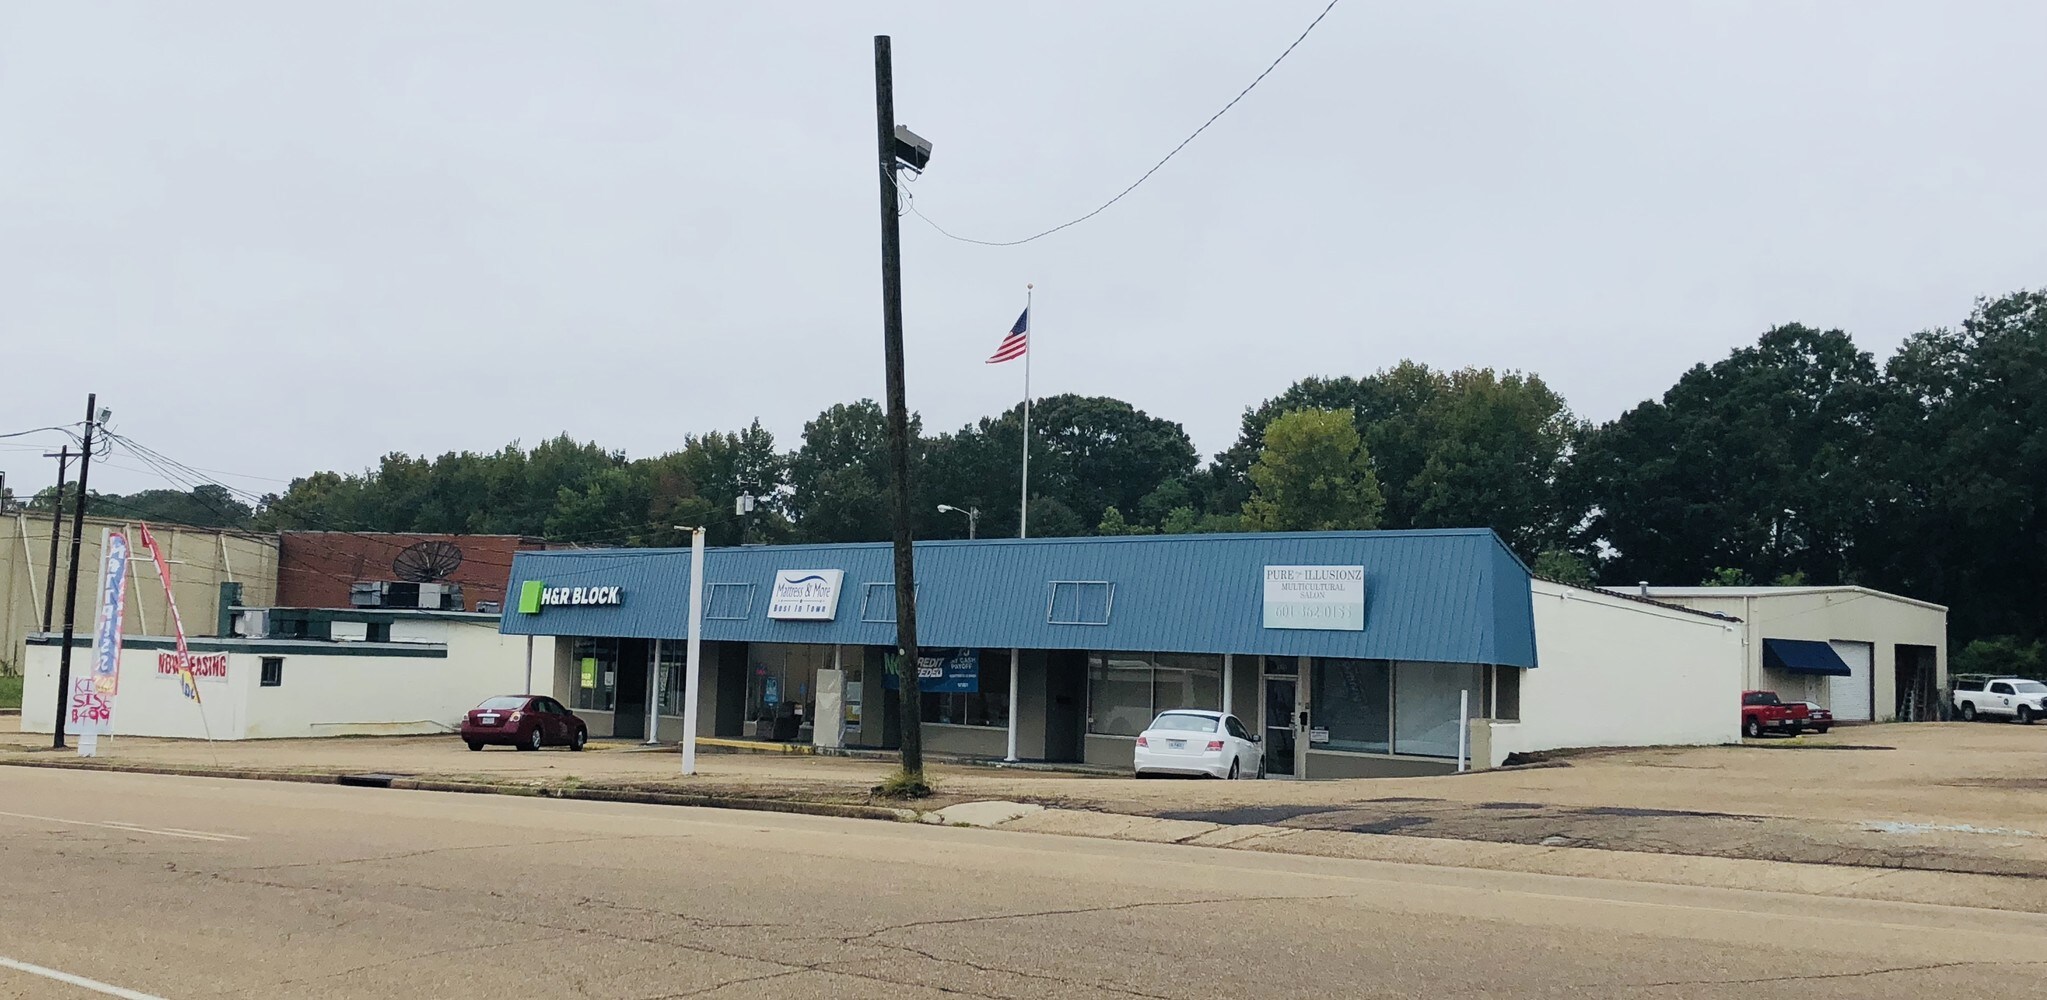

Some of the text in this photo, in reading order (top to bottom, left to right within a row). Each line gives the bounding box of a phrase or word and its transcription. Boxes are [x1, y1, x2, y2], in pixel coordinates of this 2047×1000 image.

[1267, 570, 1362, 581] PURE ILLUSIONZ
[776, 583, 831, 598] Mattress & More
[1281, 583, 1345, 592] MULTICULTURAL
[541, 586, 620, 605] H&R BLOCK
[806, 604, 826, 613] Town
[158, 653, 226, 677] NOW EASING
[917, 657, 945, 668] REDIT
